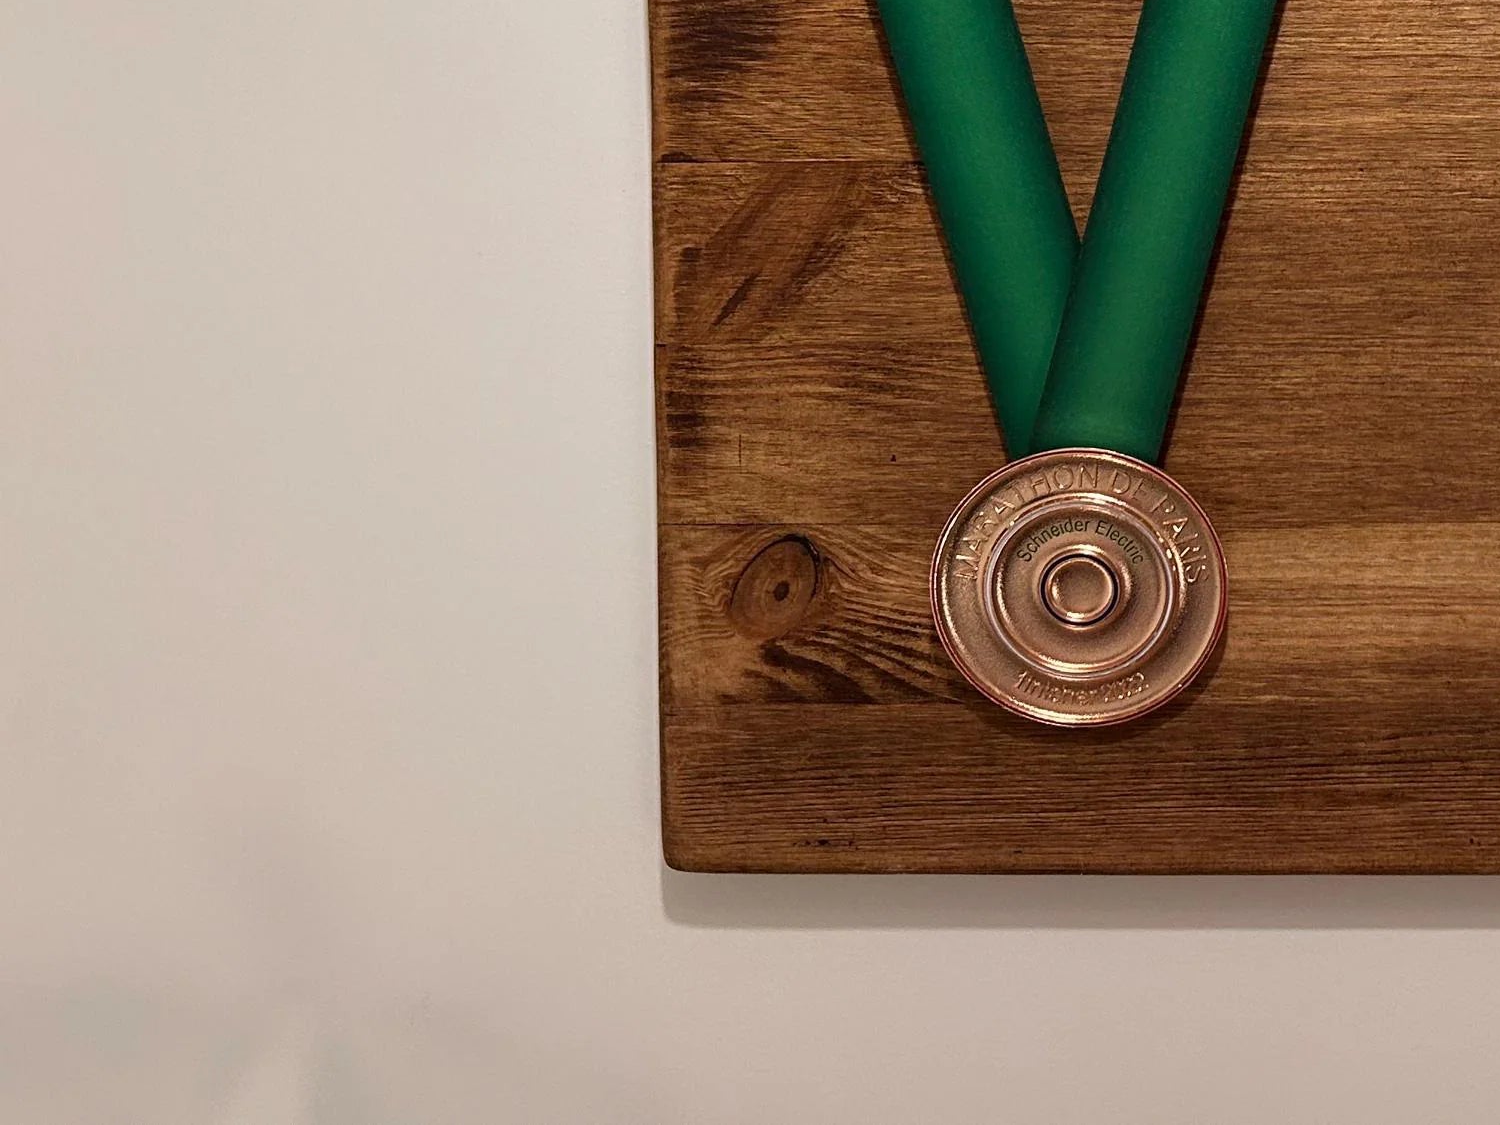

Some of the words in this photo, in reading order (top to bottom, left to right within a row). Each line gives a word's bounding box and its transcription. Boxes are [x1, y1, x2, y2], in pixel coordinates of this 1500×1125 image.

[953, 463, 1100, 581] MARATHON
[1152, 492, 1209, 585] PARIS
[1016, 518, 1089, 564] Schneider
[1094, 520, 1144, 565] Electric
